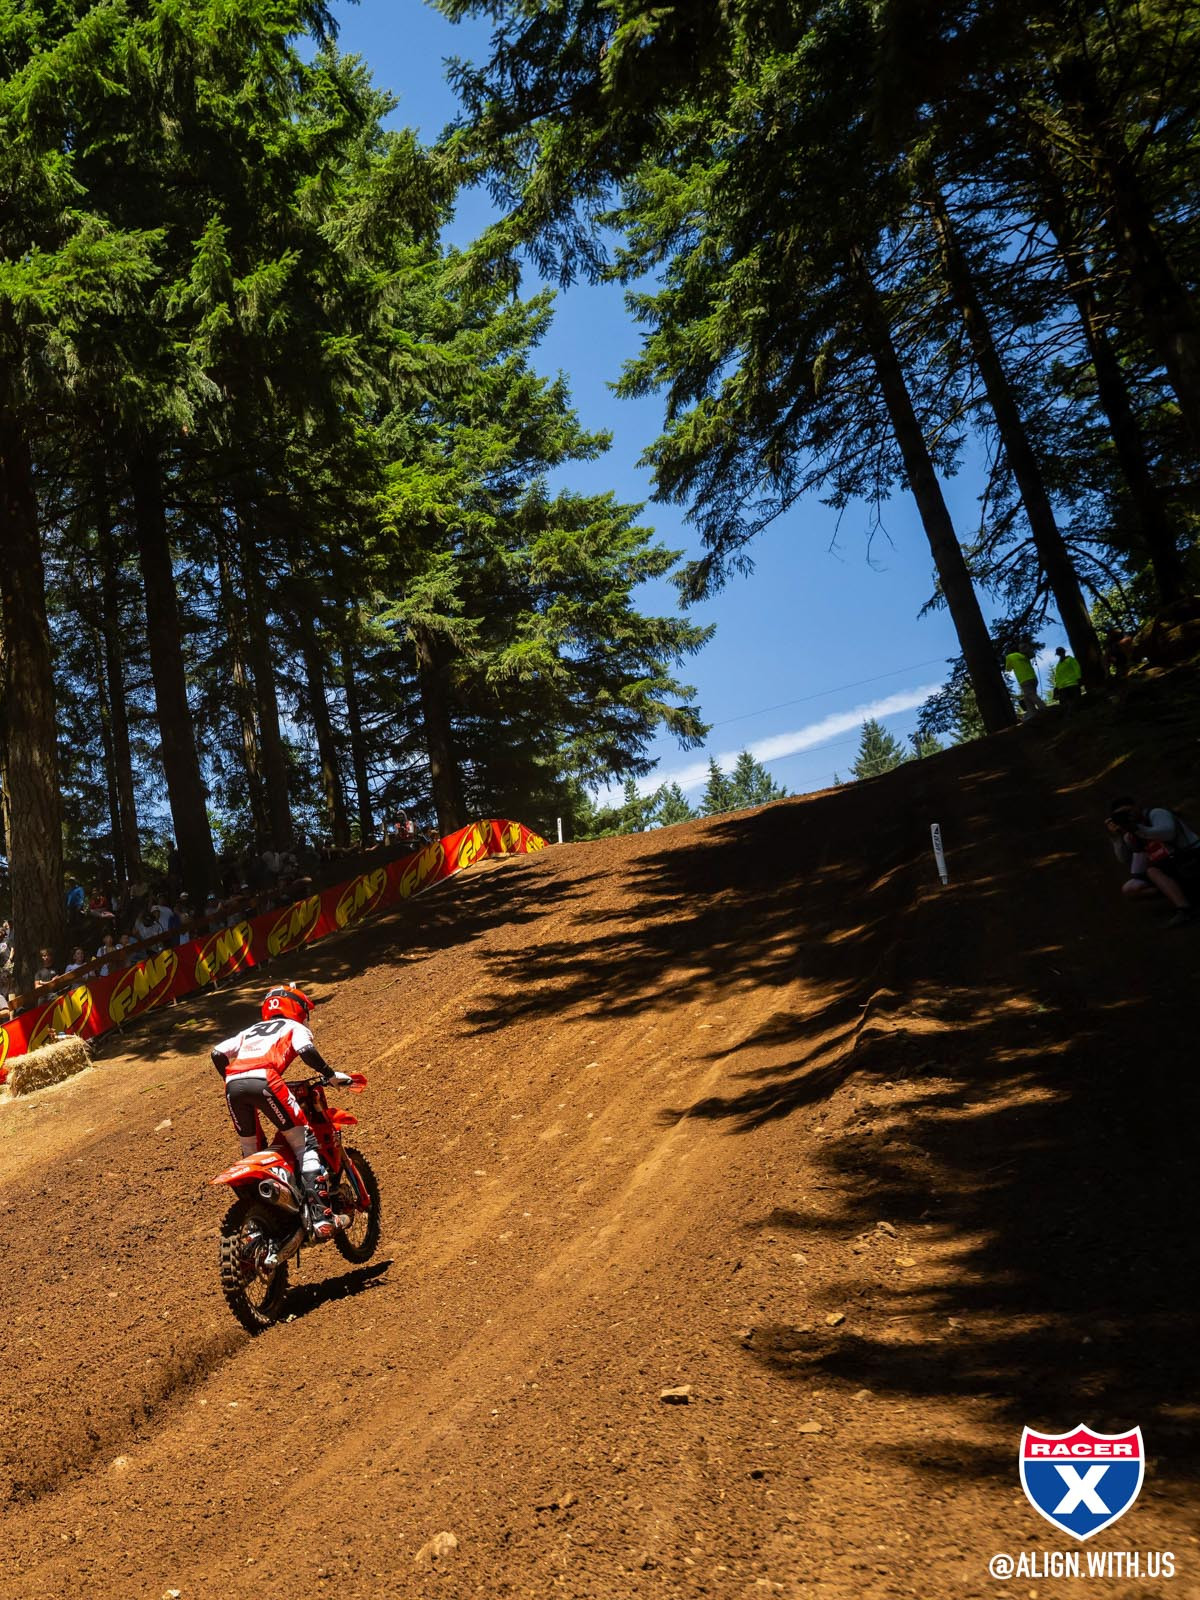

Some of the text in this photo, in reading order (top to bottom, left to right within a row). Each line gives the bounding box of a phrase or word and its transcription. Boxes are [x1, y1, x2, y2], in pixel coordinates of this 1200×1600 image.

[197, 920, 249, 986] FMF
[111, 948, 173, 1025] FMF
[245, 1019, 286, 1040] 30
[267, 1097, 287, 1125] HONDA
